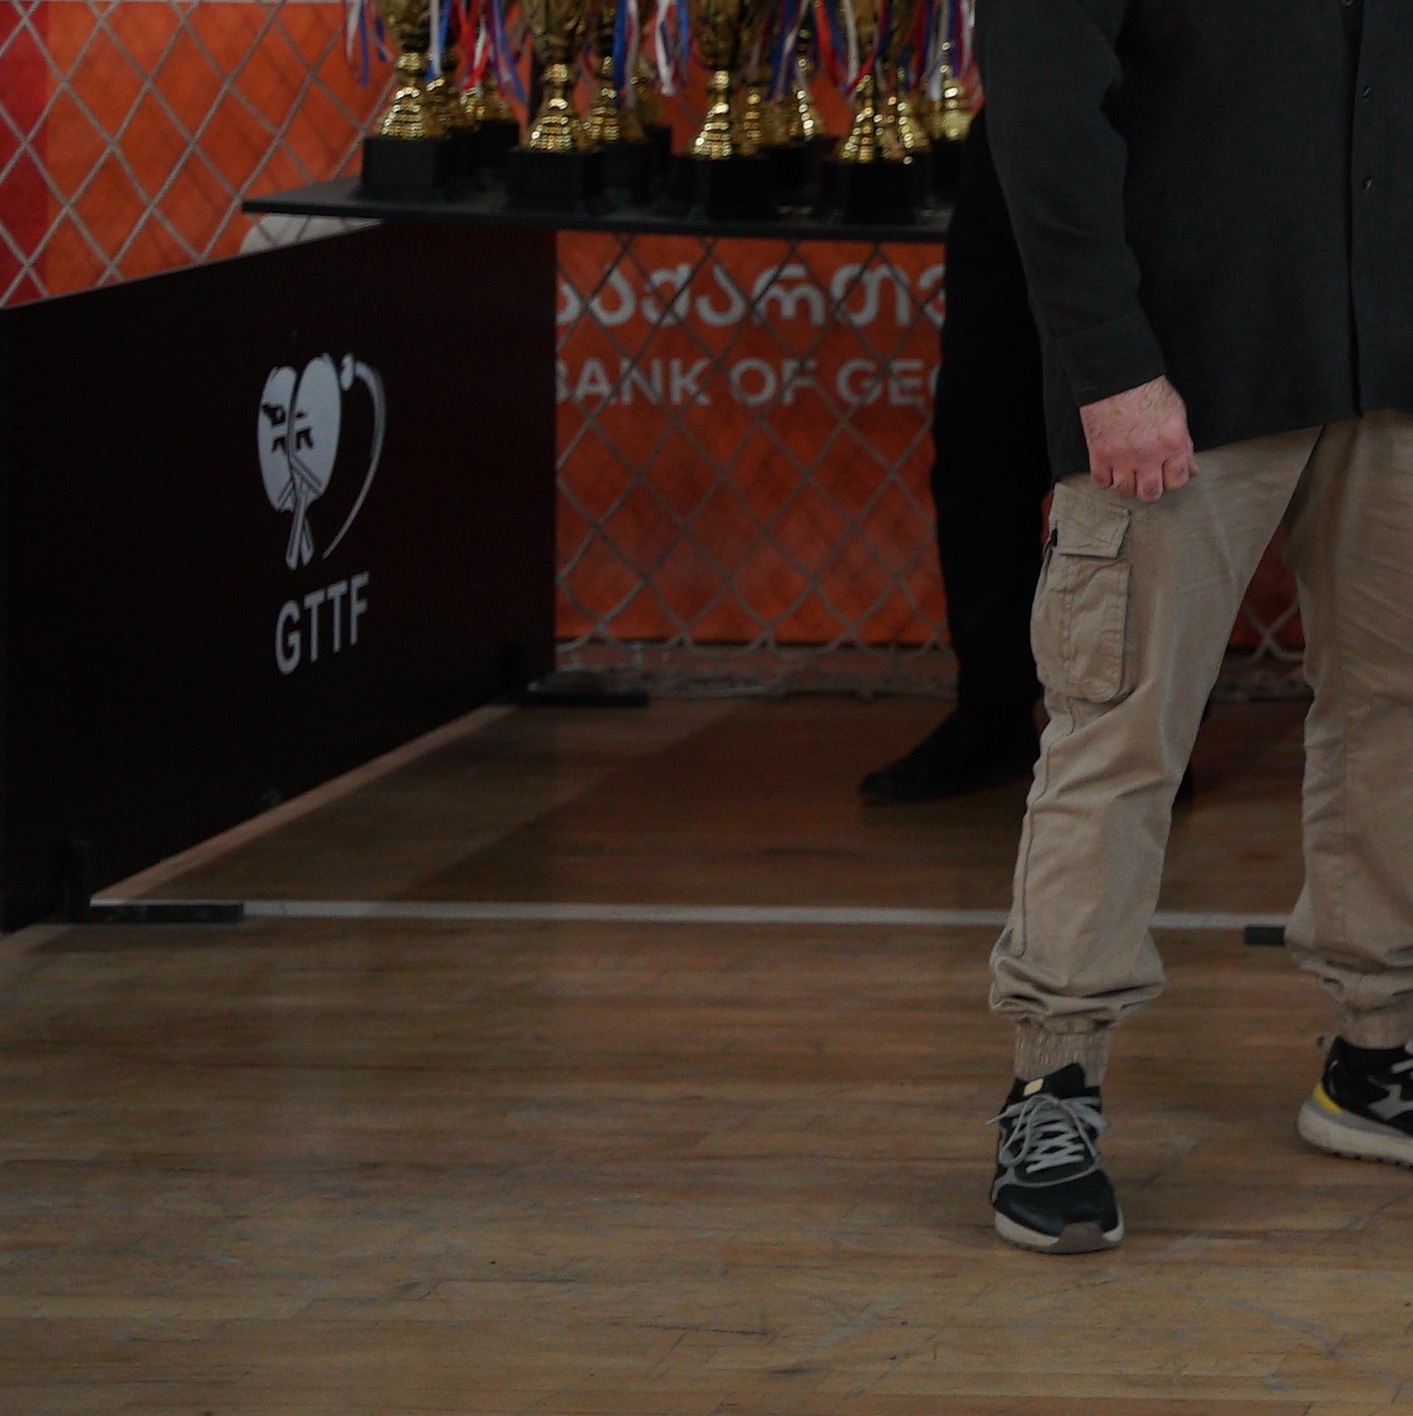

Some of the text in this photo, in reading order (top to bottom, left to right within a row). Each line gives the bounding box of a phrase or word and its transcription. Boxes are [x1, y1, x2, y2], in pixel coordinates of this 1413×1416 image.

[729, 357, 817, 407] OF
[834, 357, 941, 408] GE
[274, 570, 370, 676] GTTF
